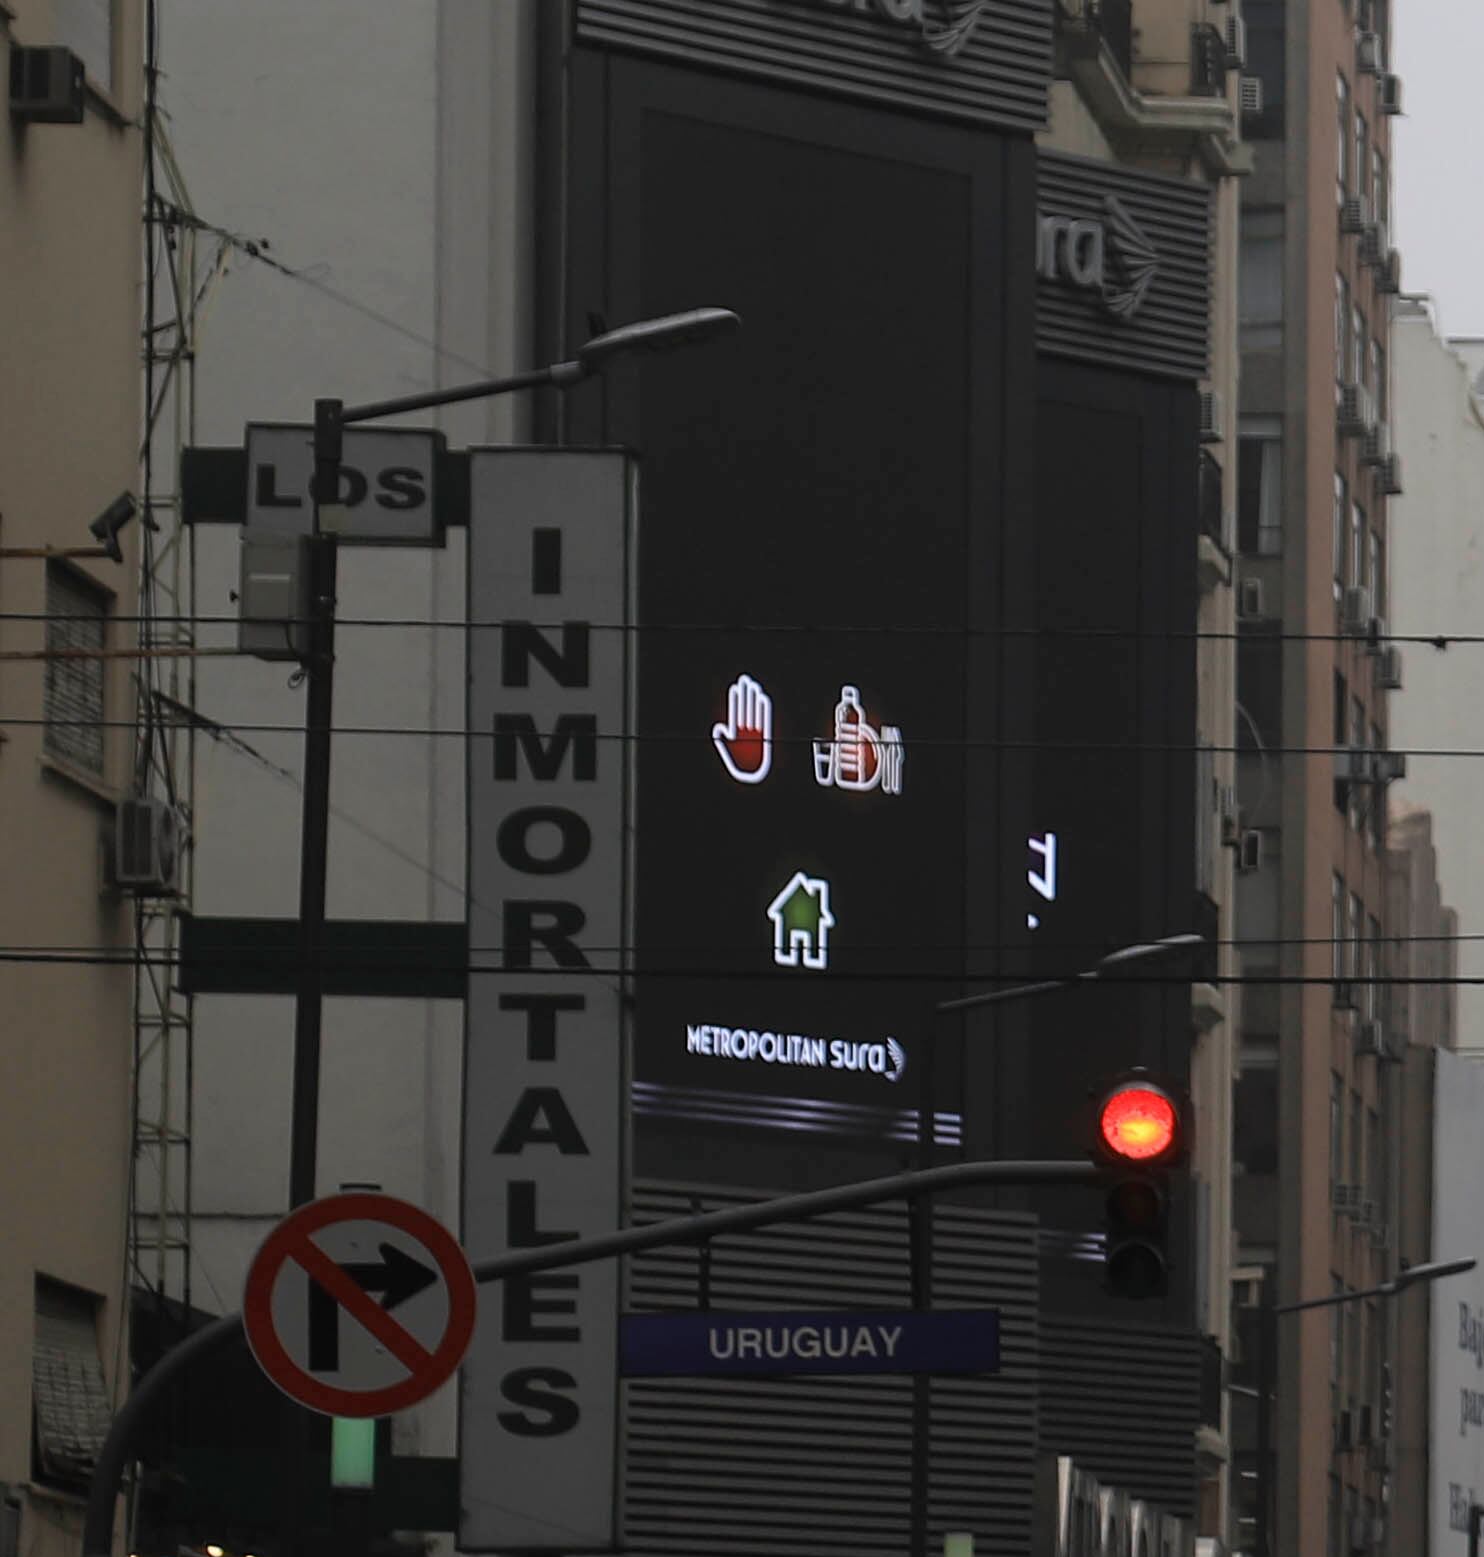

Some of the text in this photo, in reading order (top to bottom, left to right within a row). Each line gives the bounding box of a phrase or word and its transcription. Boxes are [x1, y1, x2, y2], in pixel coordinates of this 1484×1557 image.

[257, 464, 426, 509] LOS
[492, 528, 597, 1438] INMORTALES
[686, 1023, 887, 1073] METROPOLITAN sura
[709, 1326, 903, 1360] URUGUAY
